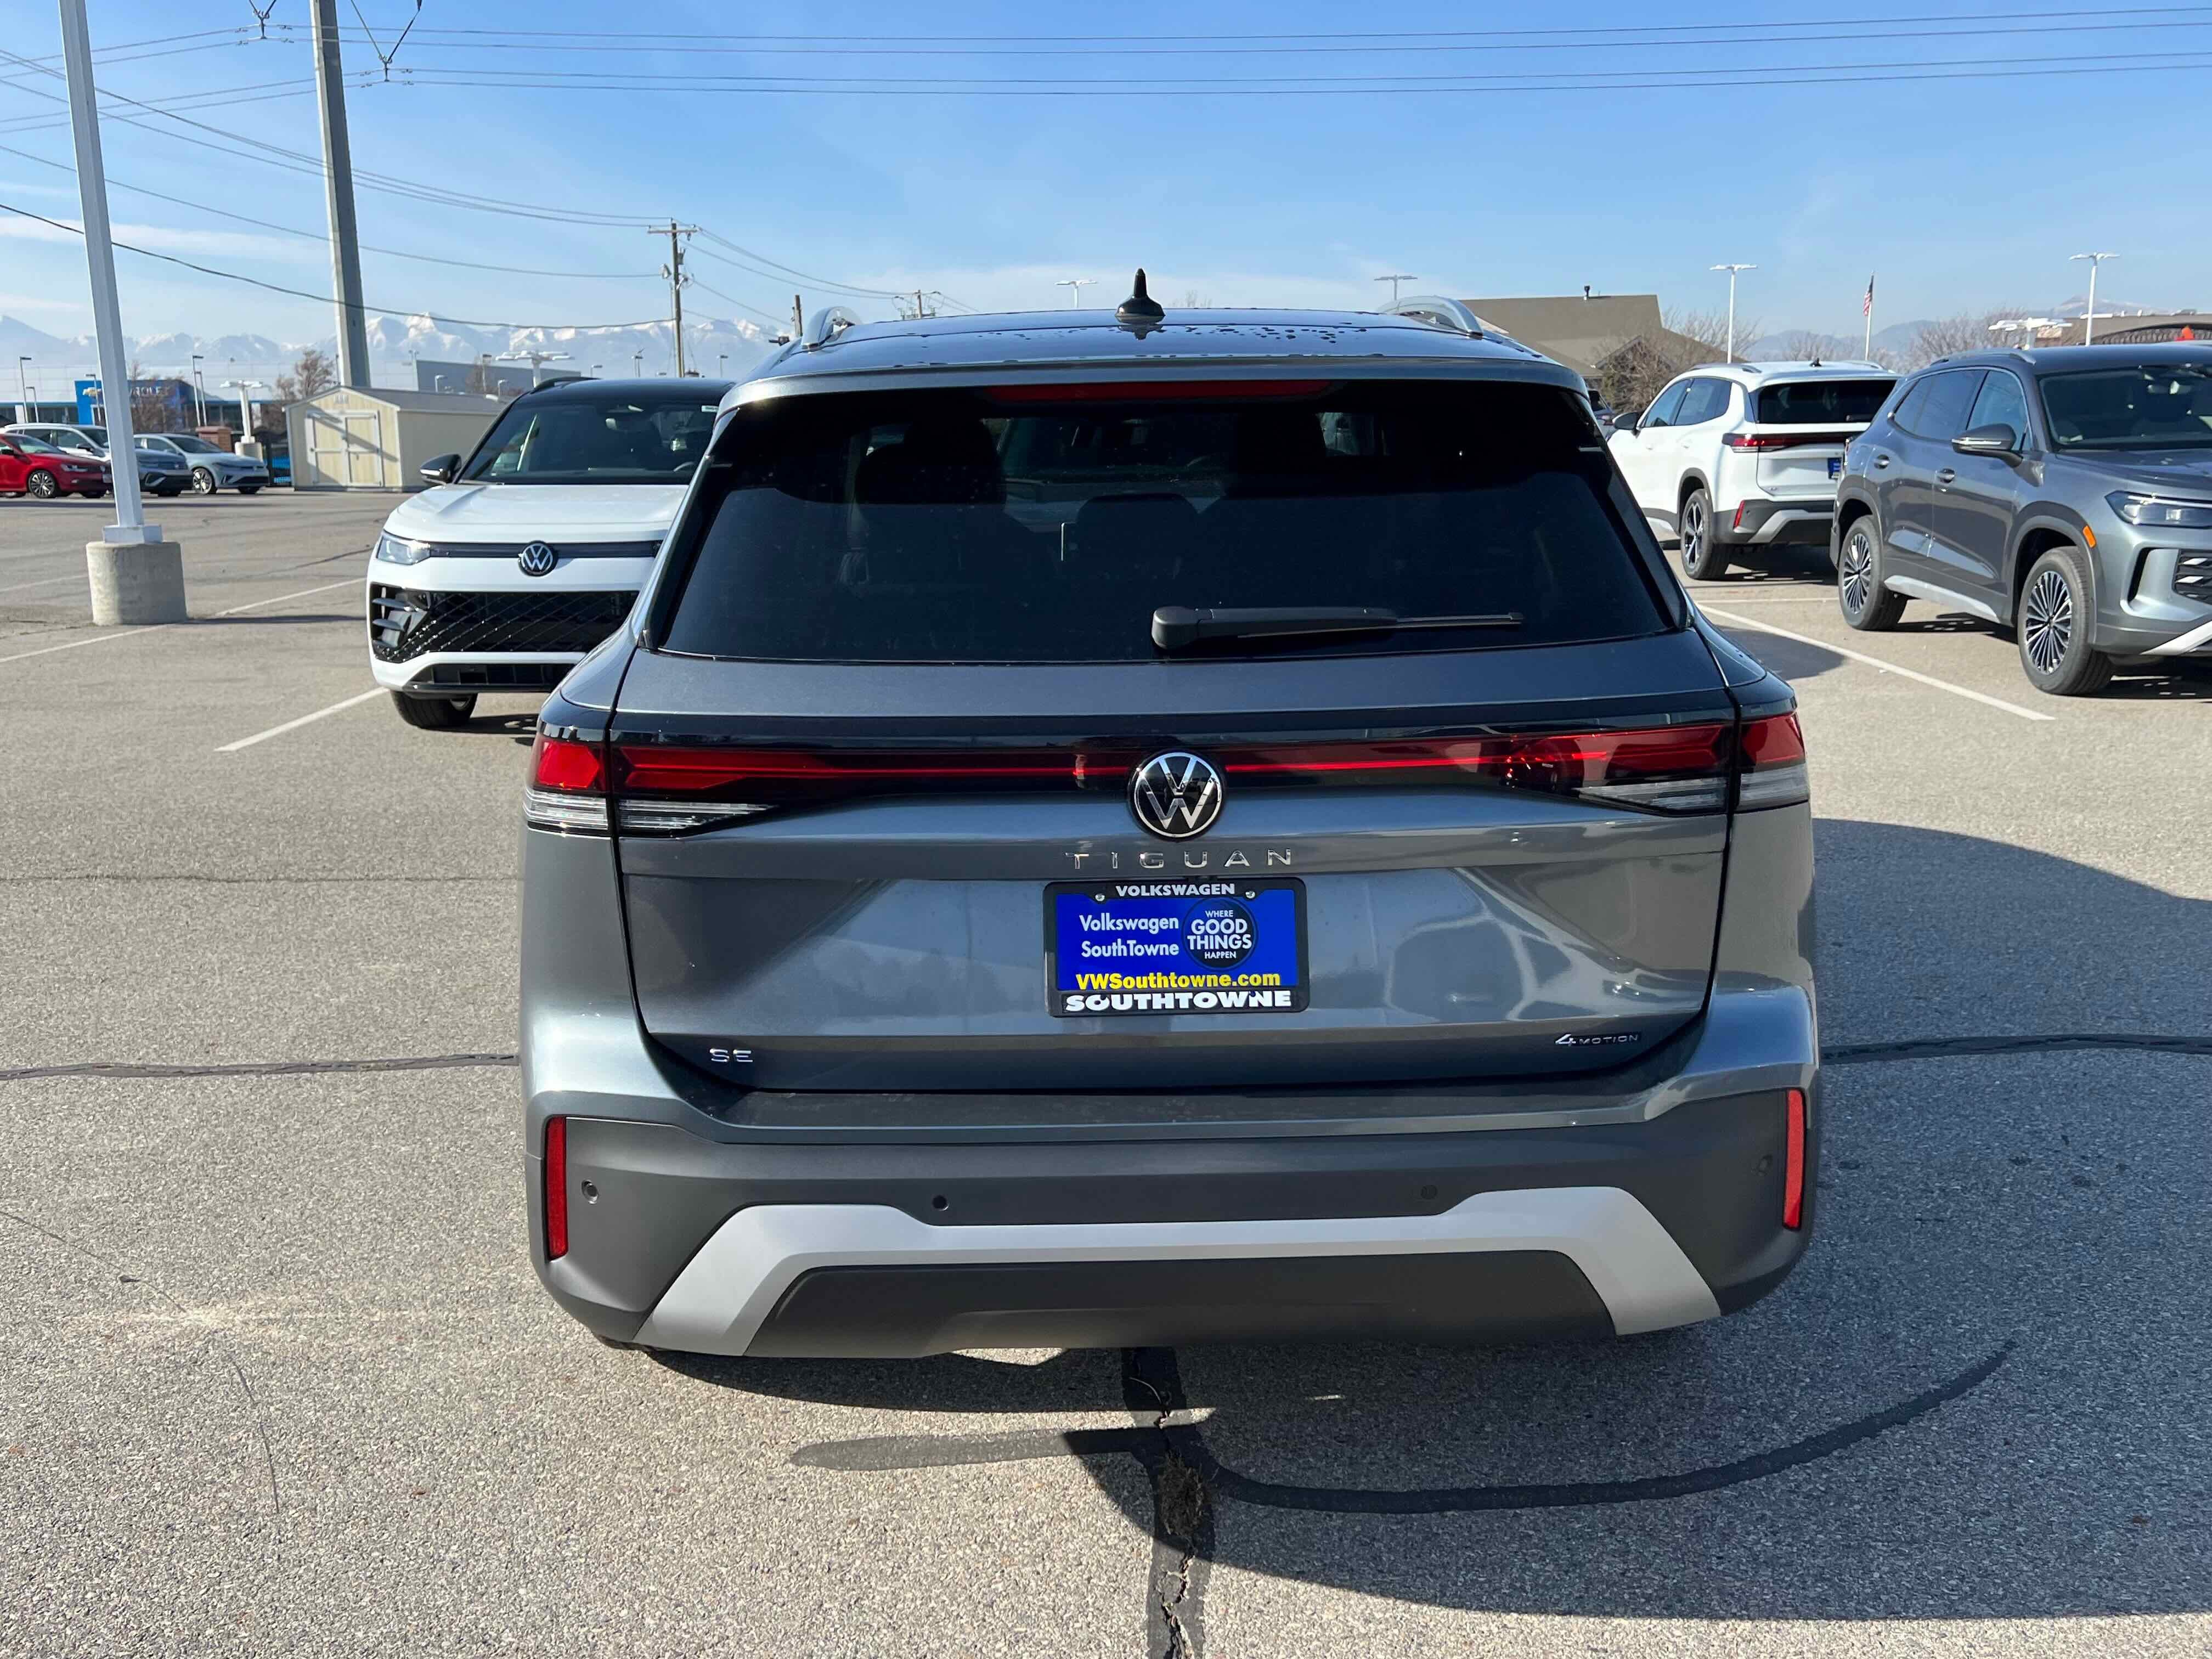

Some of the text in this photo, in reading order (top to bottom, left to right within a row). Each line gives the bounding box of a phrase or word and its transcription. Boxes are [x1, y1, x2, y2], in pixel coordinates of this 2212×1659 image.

[521, 543, 553, 574] VW
[1134, 752, 1221, 838] VW
[1064, 848, 1292, 870] TIGUAN
[1115, 883, 1235, 897] VOLKSWAGEN
[1205, 910, 1234, 918] WHERE
[1079, 912, 1179, 934] Volkswagen
[1190, 918, 1248, 935] GOOD
[1081, 939, 1180, 957] SouthTowne
[1187, 934, 1252, 950] THINGS
[1204, 950, 1237, 960] HAPPEN
[1076, 972, 1281, 990] VWSouthtowne.com
[1065, 990, 1292, 1012] SOUTHTOWNE
[1555, 1034, 1639, 1046] 4MOTION
[709, 1048, 753, 1062] SE
